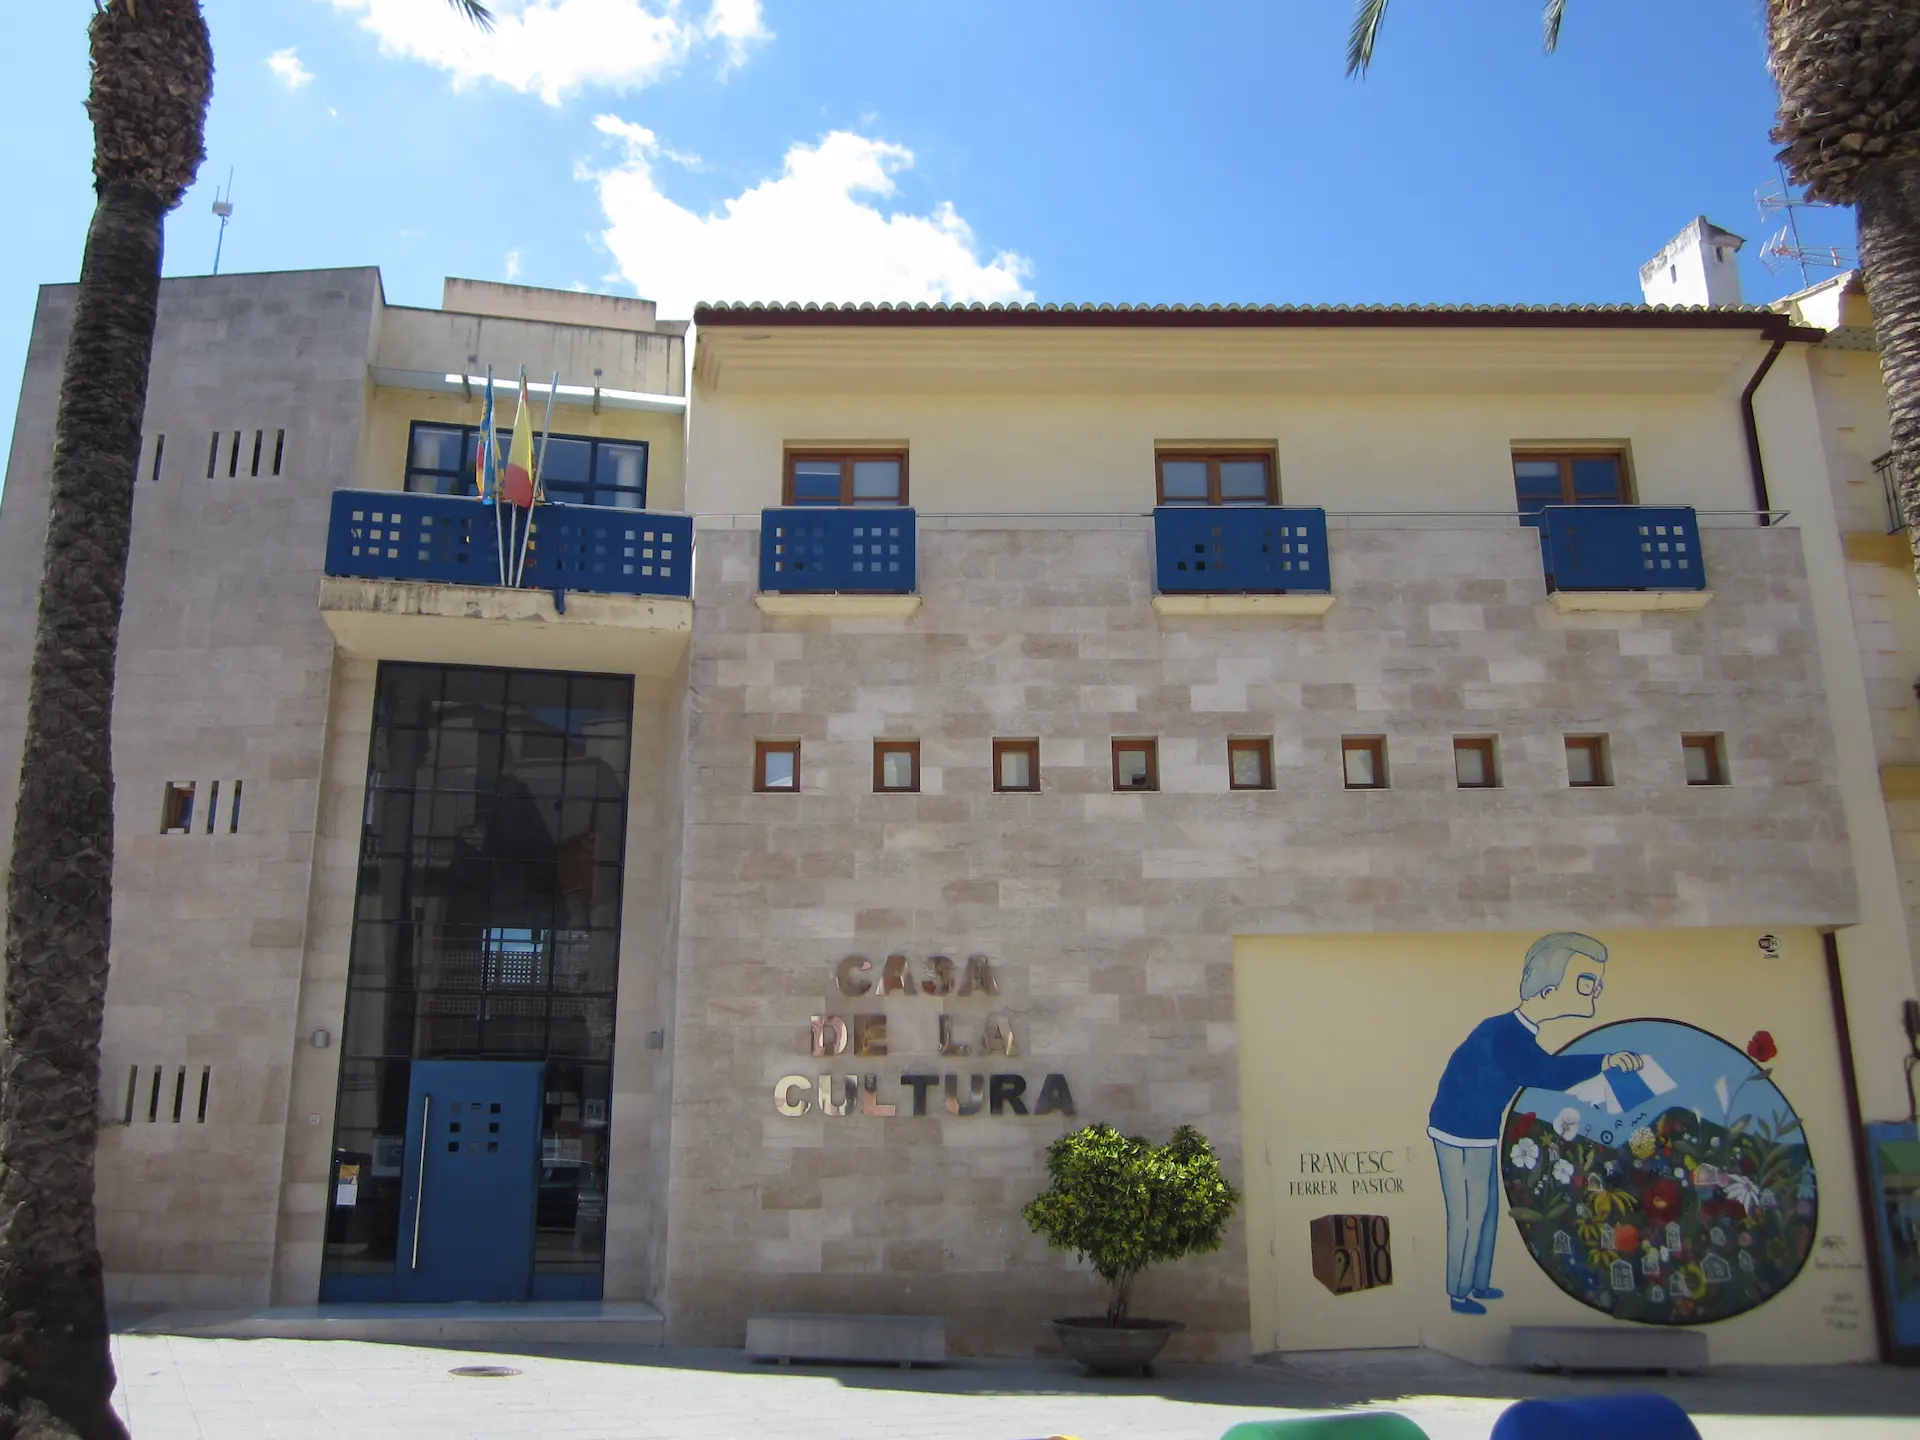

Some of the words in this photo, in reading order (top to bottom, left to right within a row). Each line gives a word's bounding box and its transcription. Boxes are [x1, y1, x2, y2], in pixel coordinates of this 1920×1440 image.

[835, 955, 1000, 997] CASA
[809, 1014, 888, 1057] DE
[938, 1014, 1017, 1057] LA
[773, 1072, 1076, 1117] CULTURA
[1299, 1150, 1395, 1175] FRANCESC
[1289, 1180, 1338, 1196] FERRER
[1351, 1177, 1404, 1195] PASTOR
